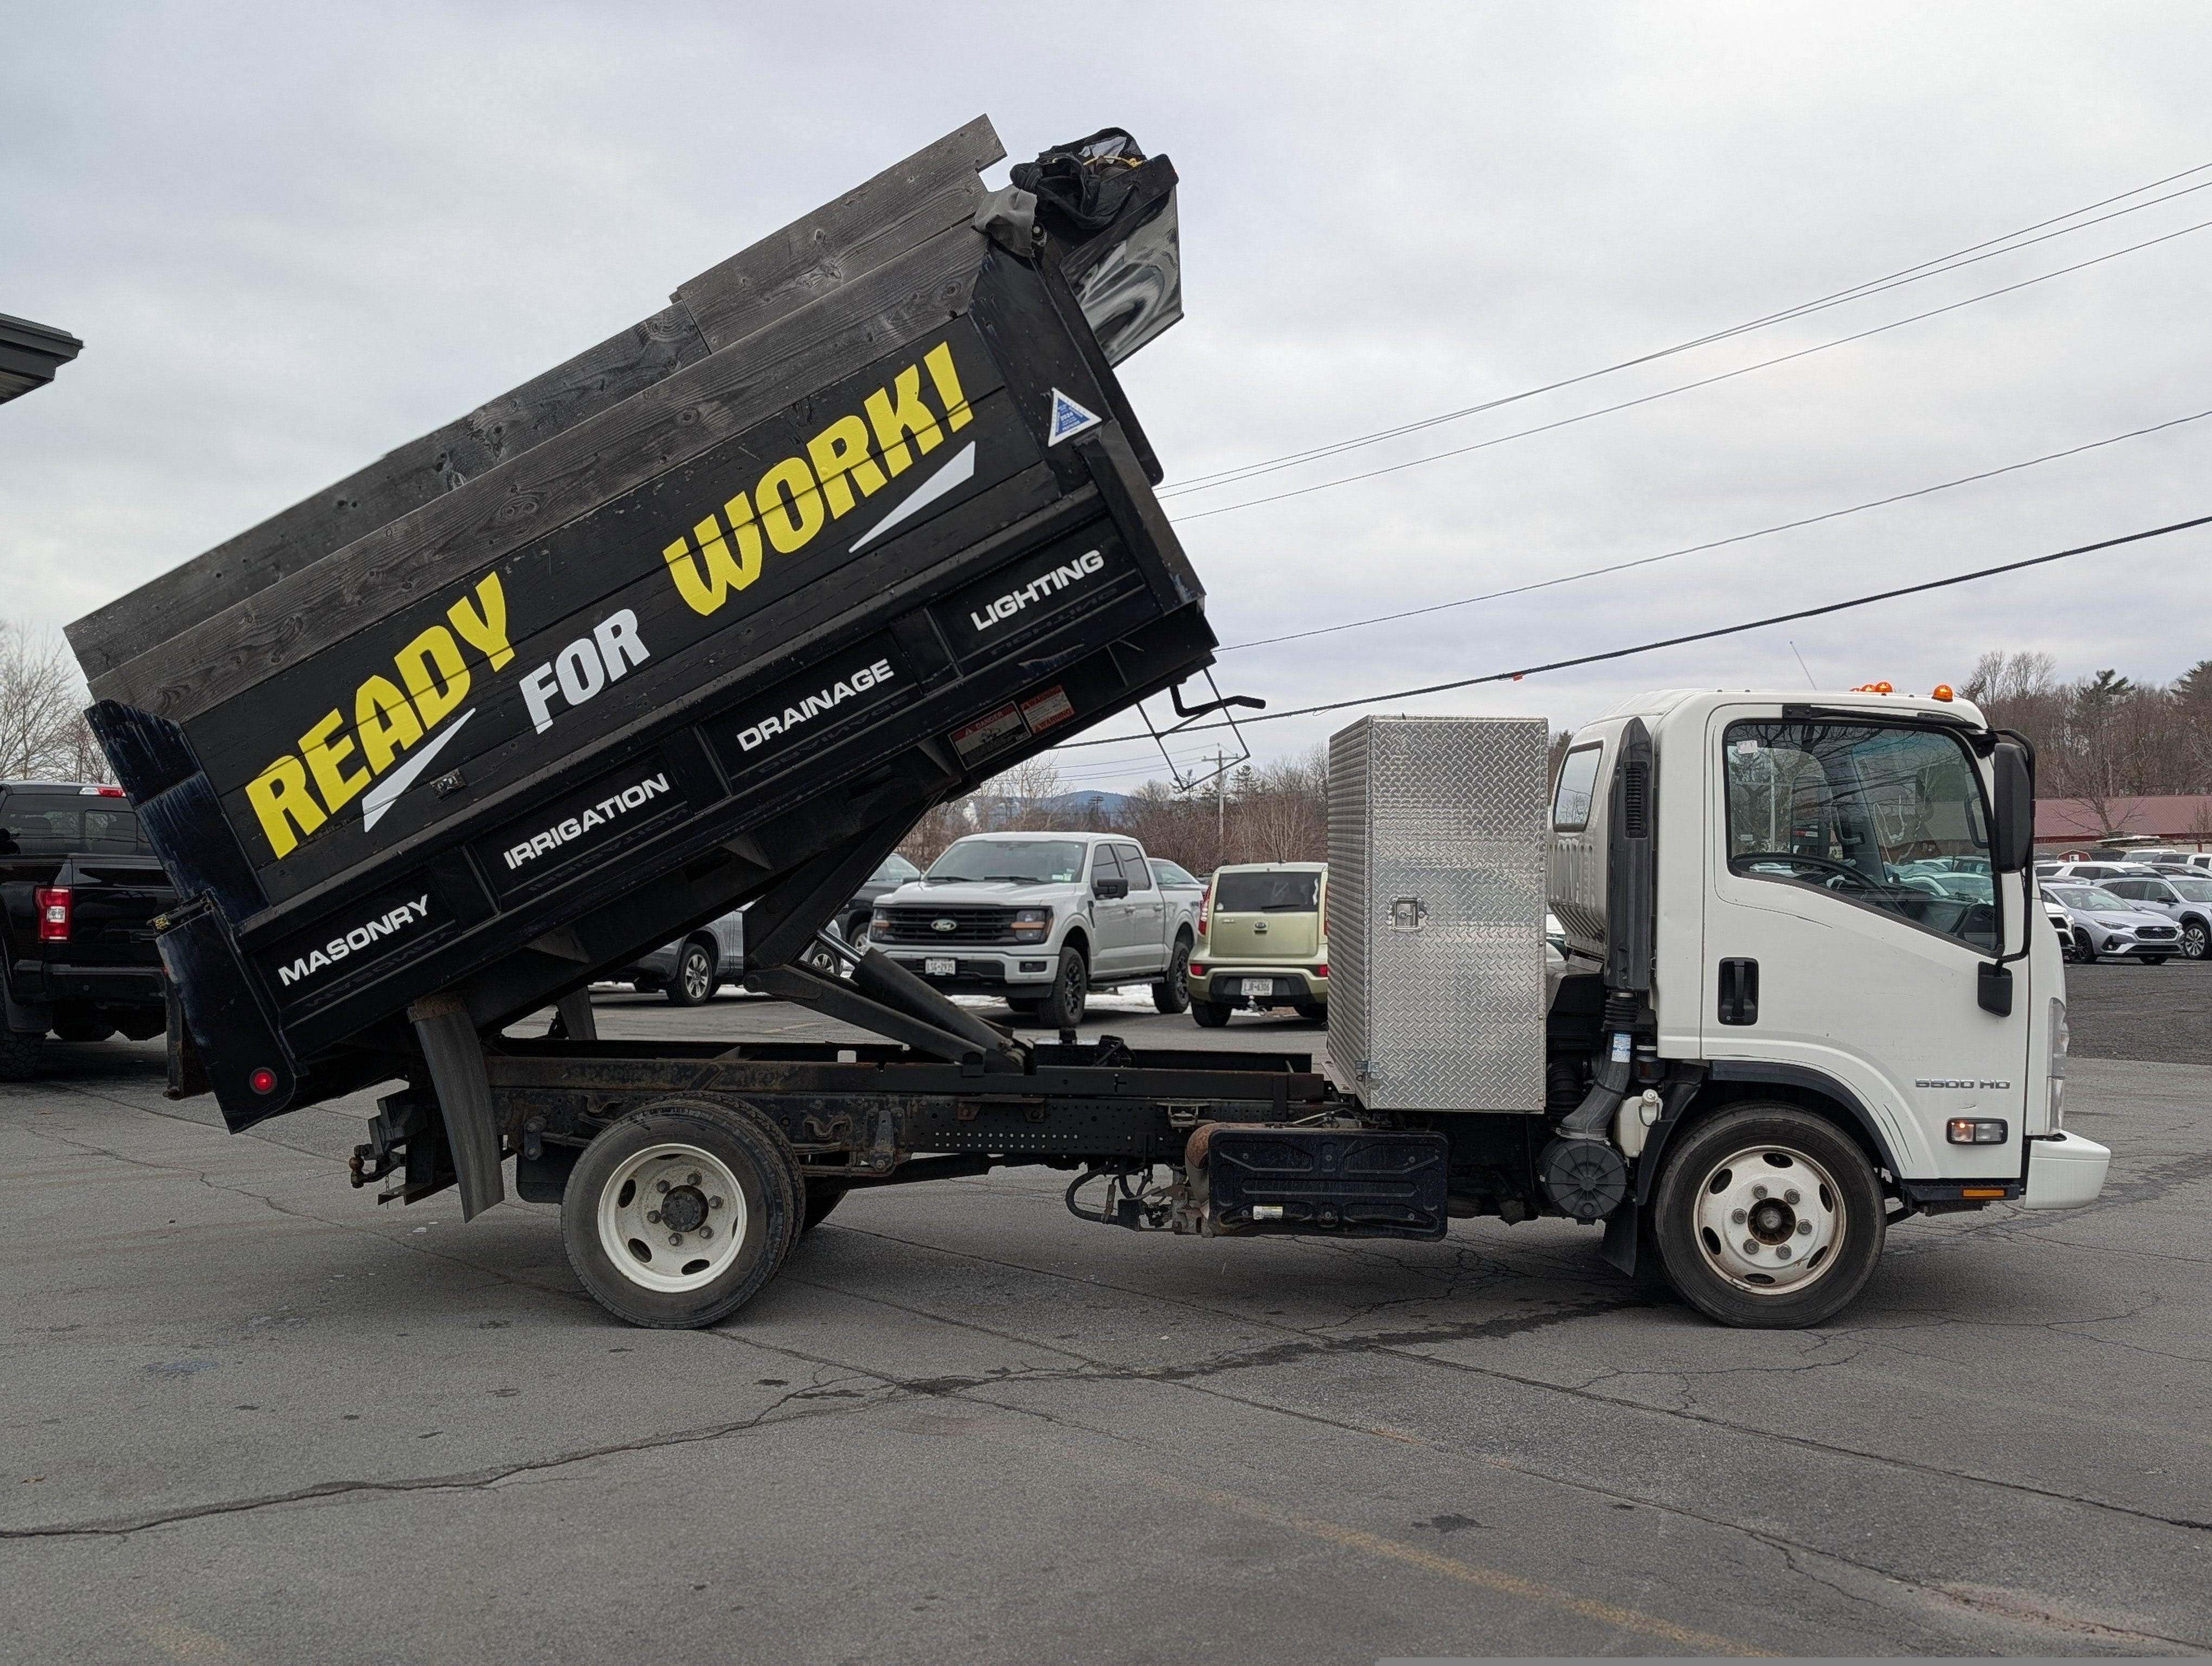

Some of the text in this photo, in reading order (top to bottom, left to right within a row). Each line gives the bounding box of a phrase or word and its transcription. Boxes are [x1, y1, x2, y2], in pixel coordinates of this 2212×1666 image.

[245, 341, 973, 860] READY FOR WORK!
[970, 549, 1104, 631] LIGHTING
[737, 658, 893, 751] DRAINAGE
[976, 712, 1003, 729] DANGER
[504, 773, 670, 869] IRRIGATION
[278, 894, 428, 985] MASONRY
[1915, 1079, 2010, 1089] 5500 HD
